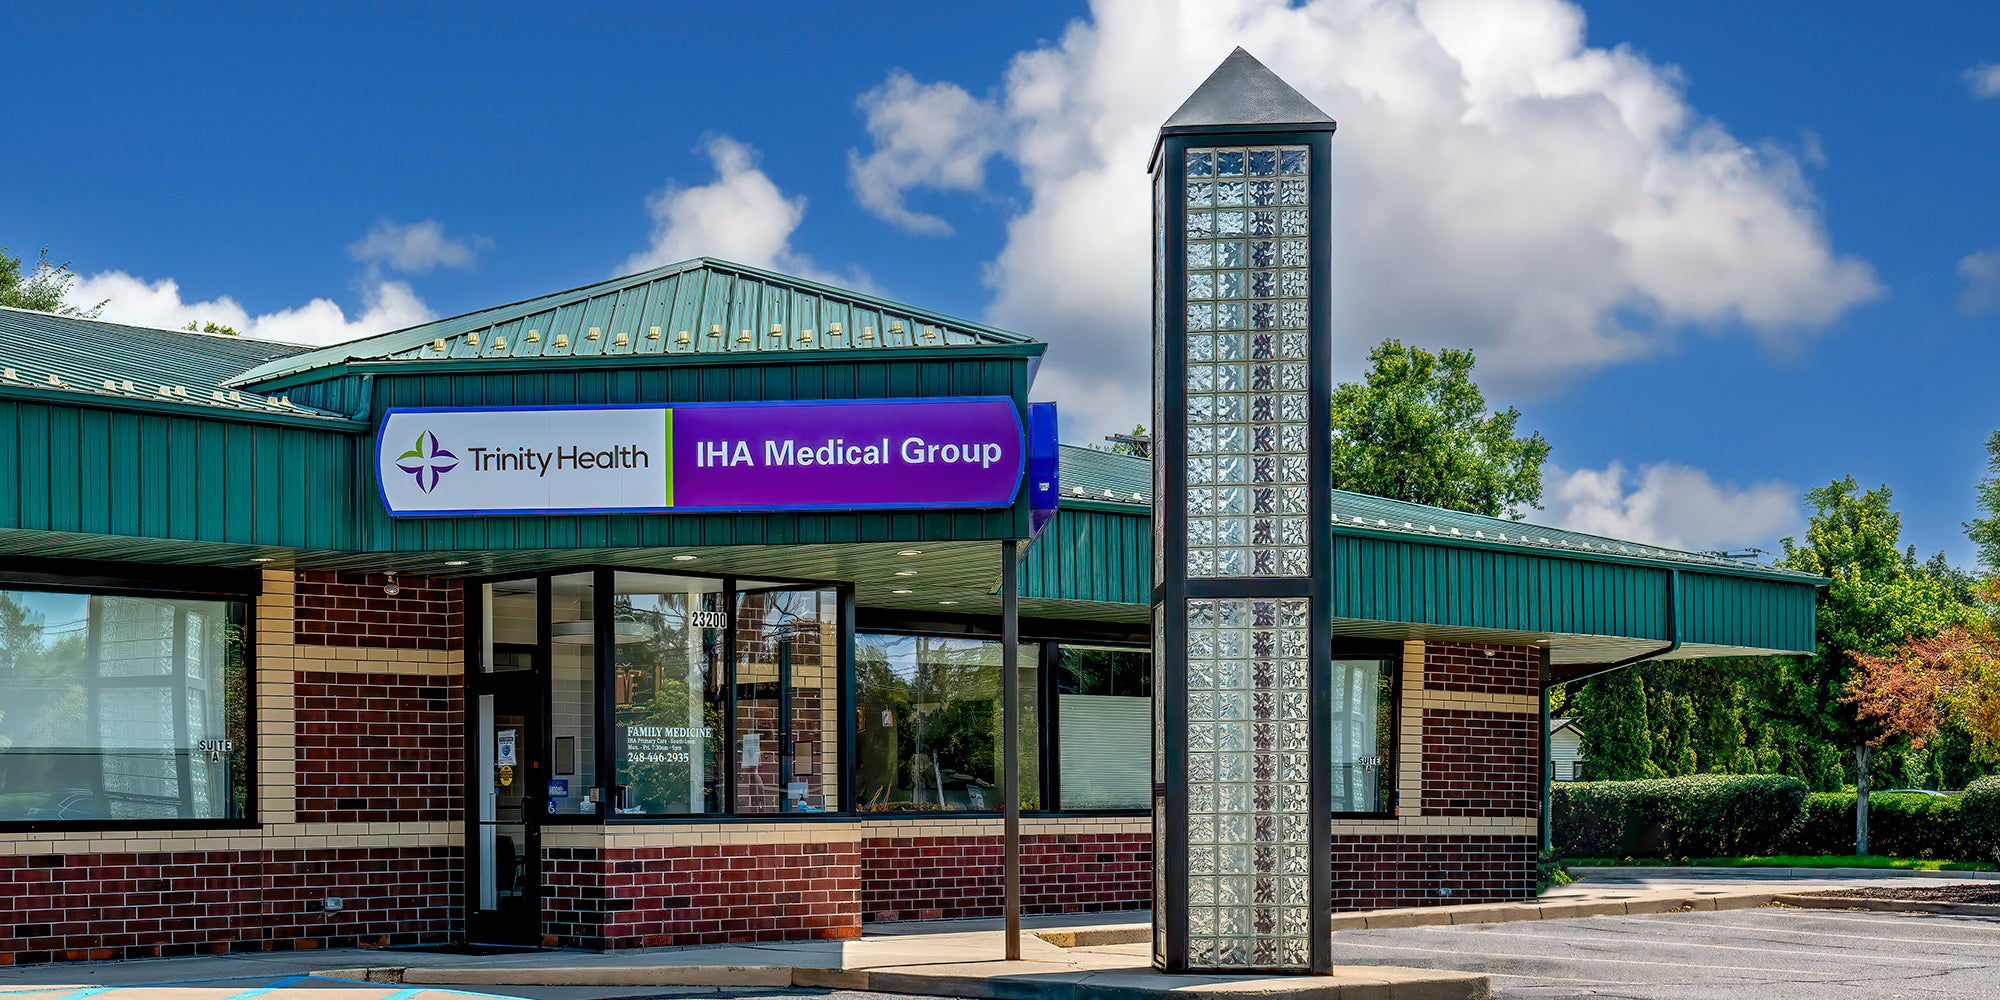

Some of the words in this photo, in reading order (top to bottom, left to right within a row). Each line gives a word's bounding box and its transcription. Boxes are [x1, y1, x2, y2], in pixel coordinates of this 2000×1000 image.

[696, 441, 754, 468] IHA
[765, 438, 890, 468] Medical
[901, 436, 1003, 469] Group
[467, 446, 553, 477] Trinity
[557, 444, 649, 471] Health
[692, 611, 726, 628] 23200
[627, 727, 663, 737] FAMILY
[665, 727, 712, 738] MEDICINE
[199, 740, 232, 751] SUITE
[212, 751, 219, 762] A
[1358, 756, 1380, 765] SUITE
